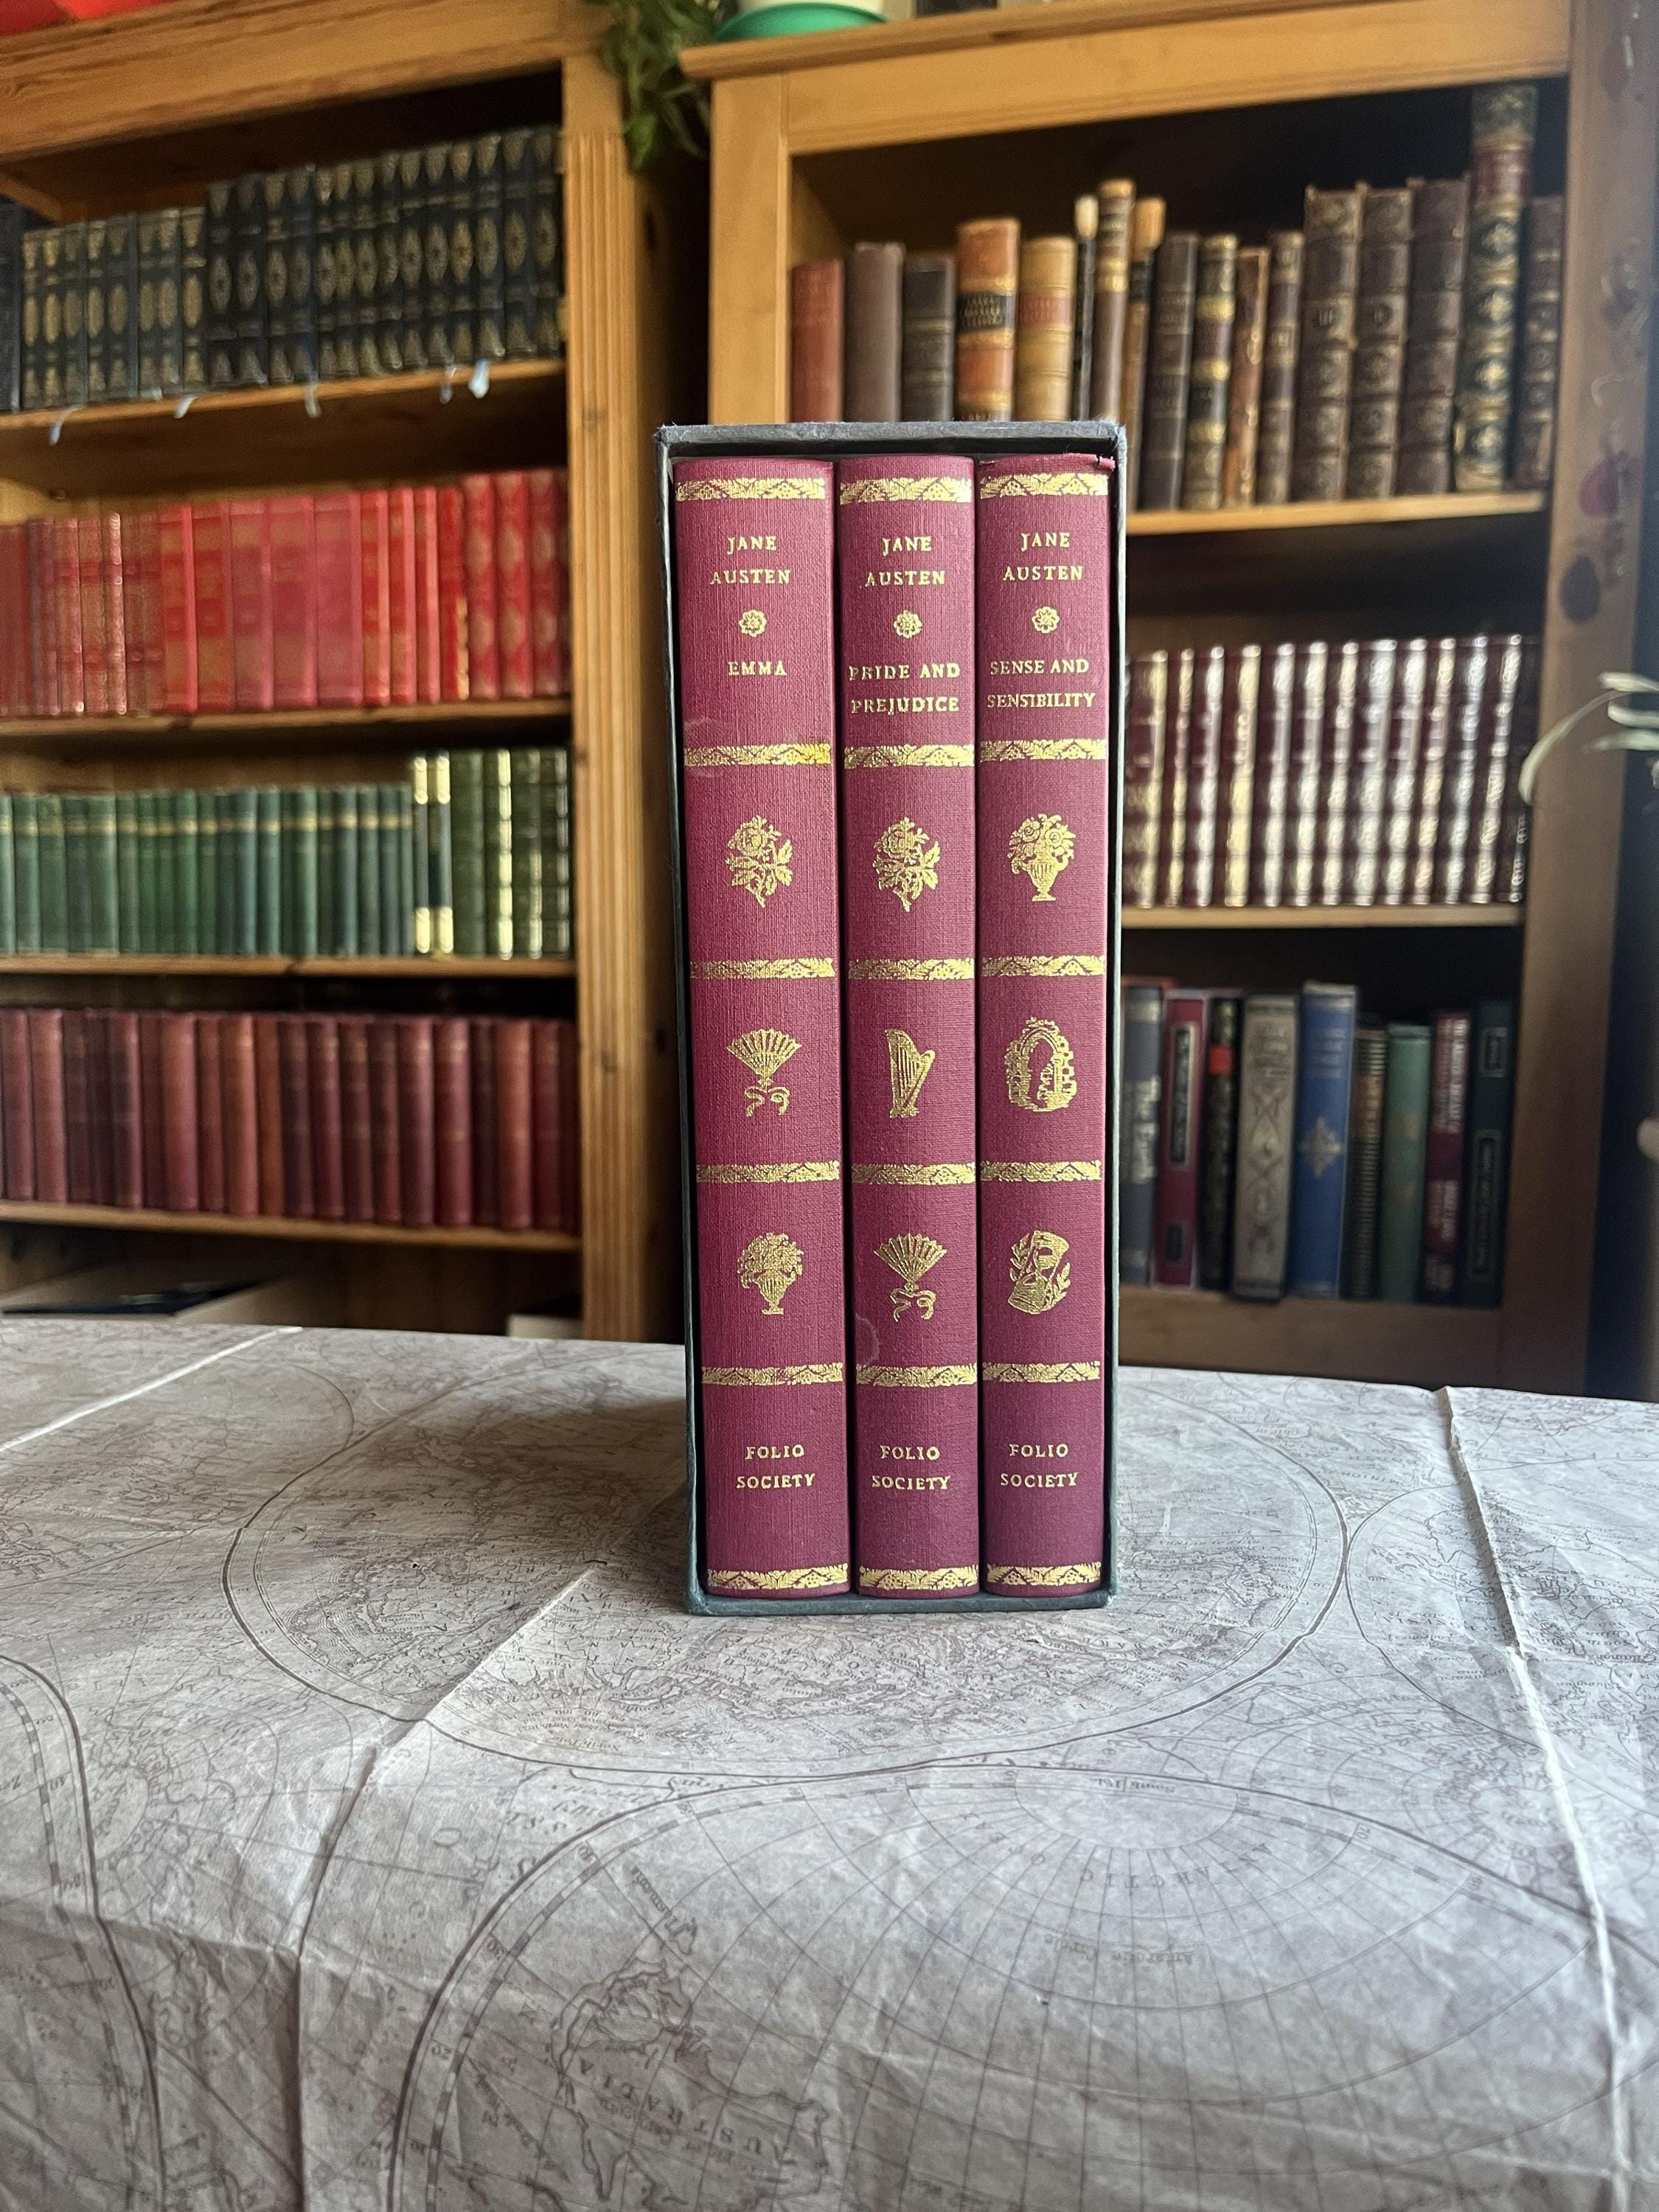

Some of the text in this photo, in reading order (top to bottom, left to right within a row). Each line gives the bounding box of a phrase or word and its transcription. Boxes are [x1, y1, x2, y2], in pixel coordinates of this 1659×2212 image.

[726, 535, 778, 554] JANE
[882, 535, 933, 557] JANE
[1020, 532, 1071, 552] JANE
[710, 569, 791, 585] AUSTEN
[865, 570, 946, 588] AUSTEN
[1002, 565, 1084, 582] AUSTEN
[727, 661, 787, 677] EMMA
[849, 662, 961, 681] PRIDE AND
[990, 658, 1091, 676] SENSE AND
[850, 696, 960, 717] PREJUDICE
[987, 692, 1096, 712] SENSIBILITY
[745, 1444, 805, 1460] FOLIO
[880, 1444, 941, 1461] FOLIO
[1009, 1443, 1068, 1458] FOLIO
[736, 1472, 815, 1489] SOCIETY
[872, 1475, 951, 1491] SOCIETY
[1001, 1472, 1079, 1488] SOCIETY
